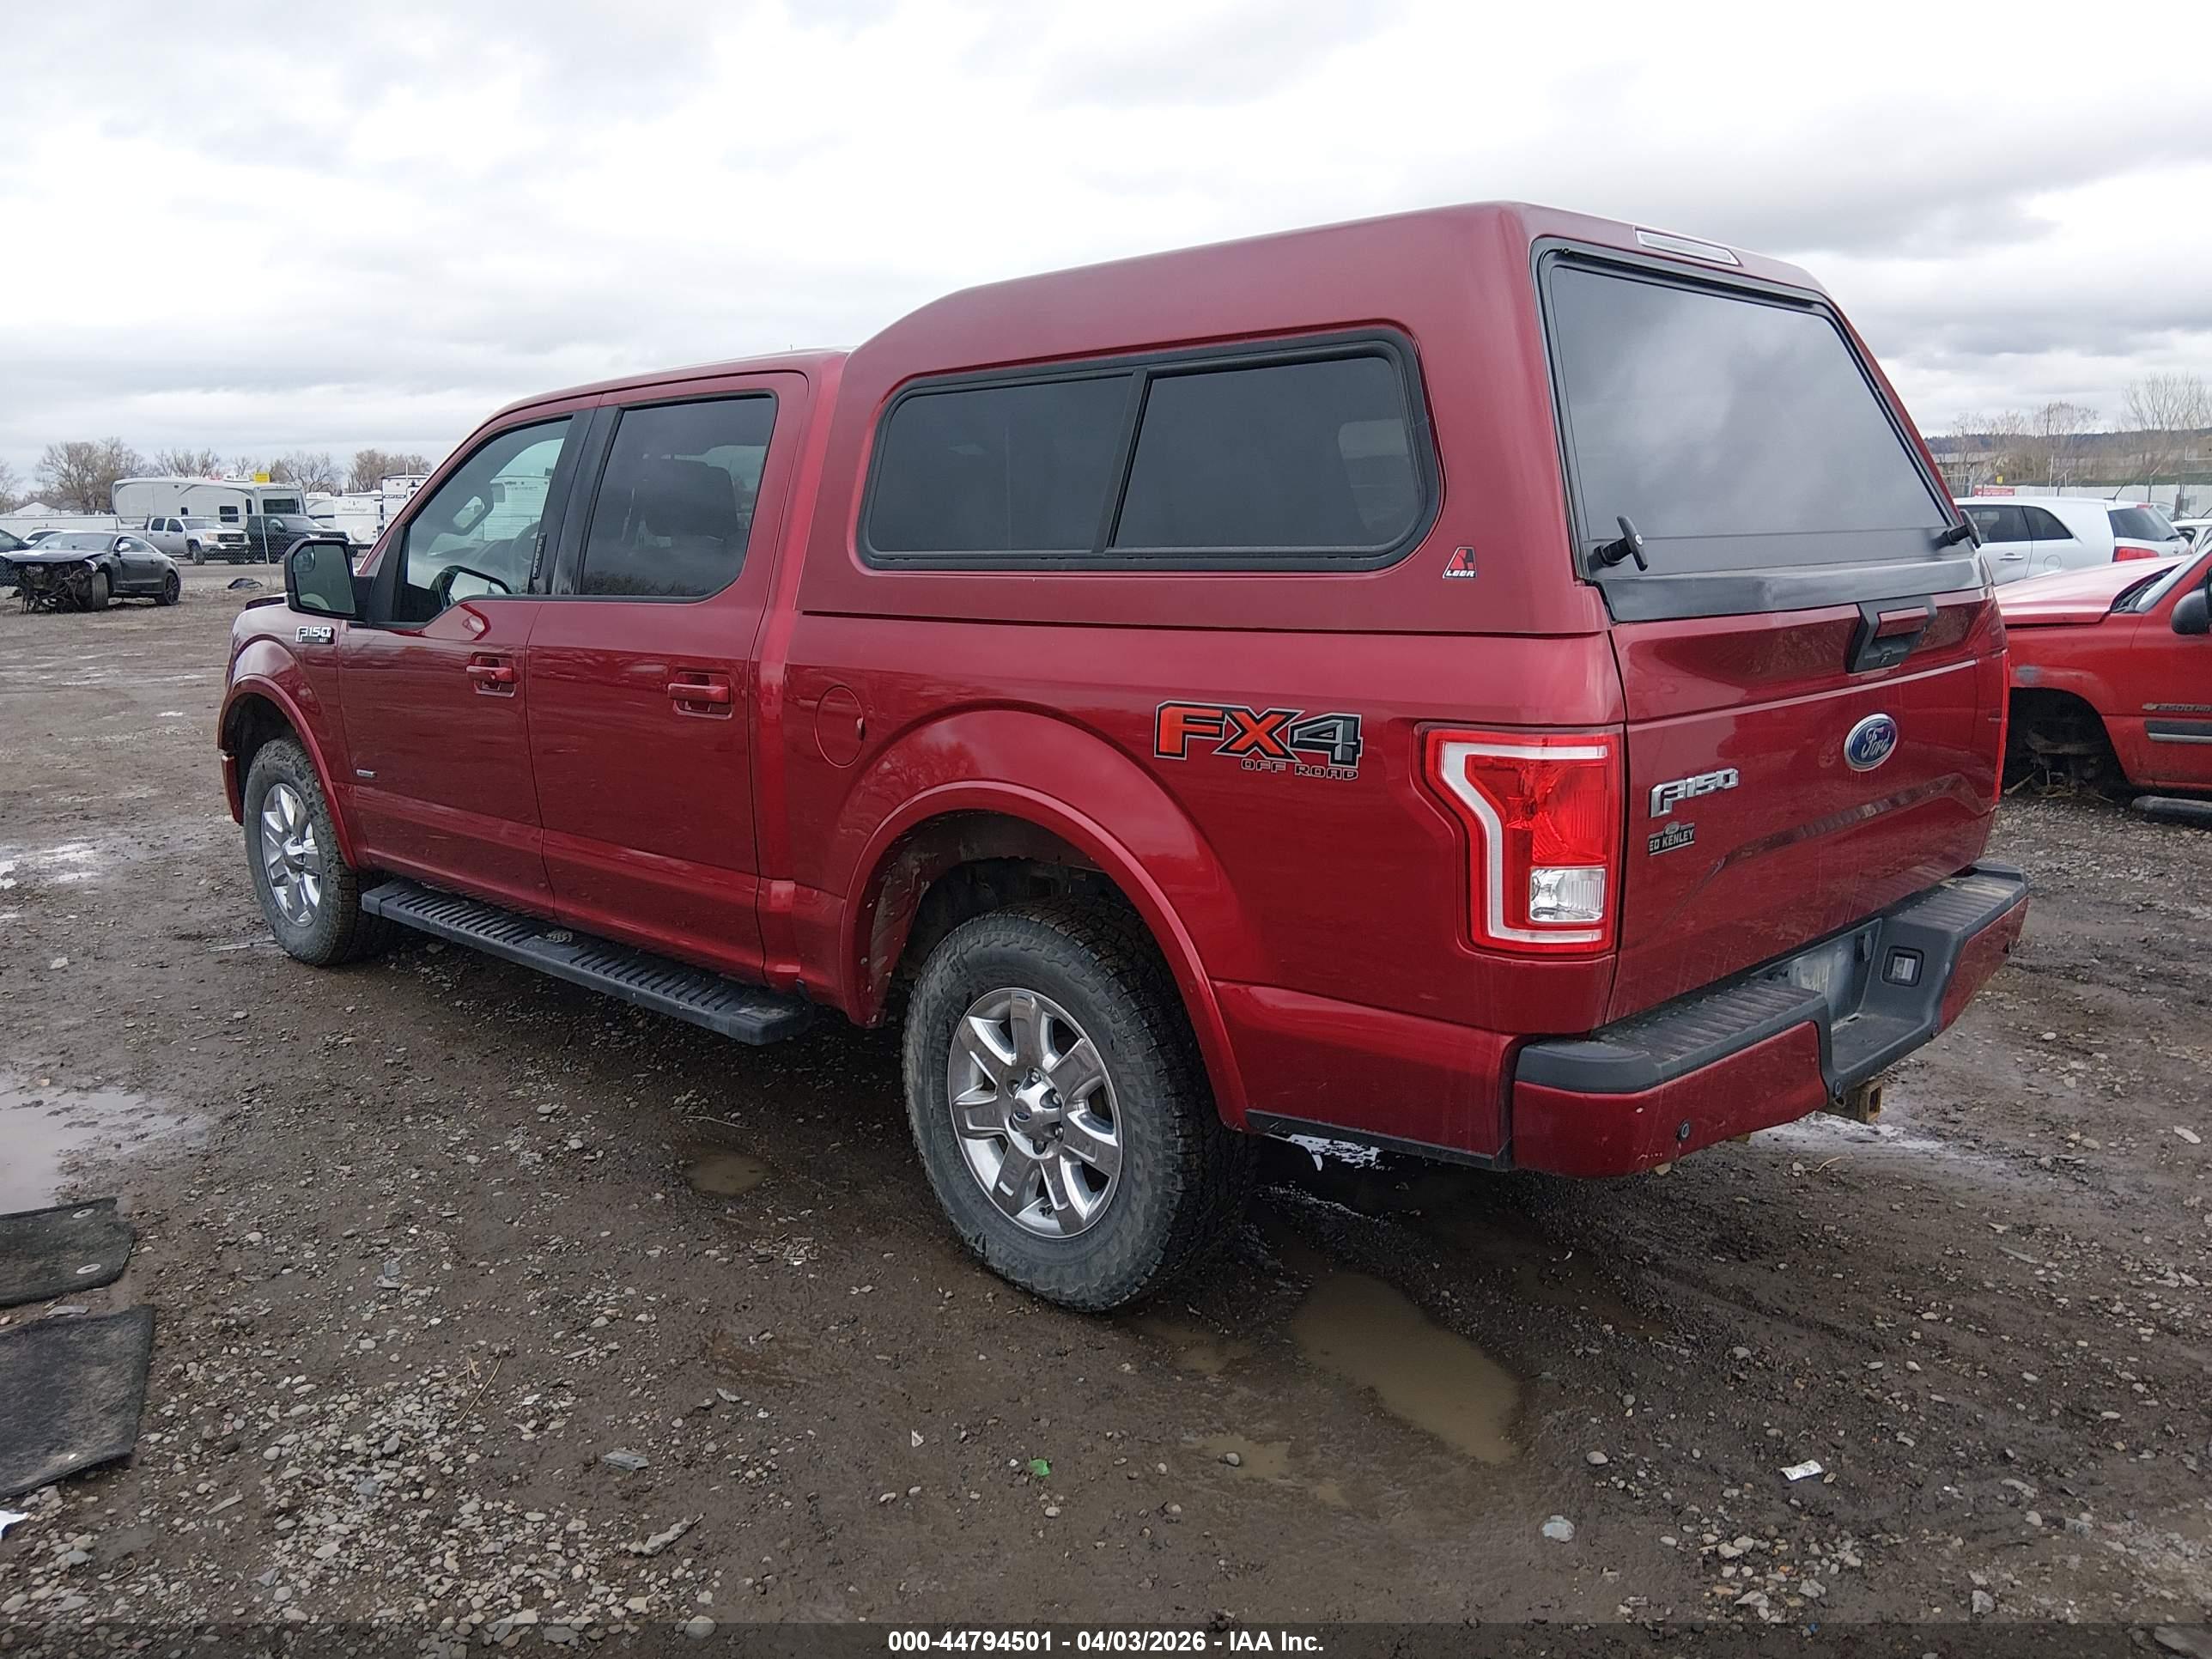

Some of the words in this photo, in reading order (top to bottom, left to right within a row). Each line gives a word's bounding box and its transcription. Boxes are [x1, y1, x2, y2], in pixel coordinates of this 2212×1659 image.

[1154, 700, 1364, 768] FX4
[1241, 758, 1286, 773] OFF
[1294, 763, 1359, 781] ROAD
[1662, 828, 1695, 848] KENLEY
